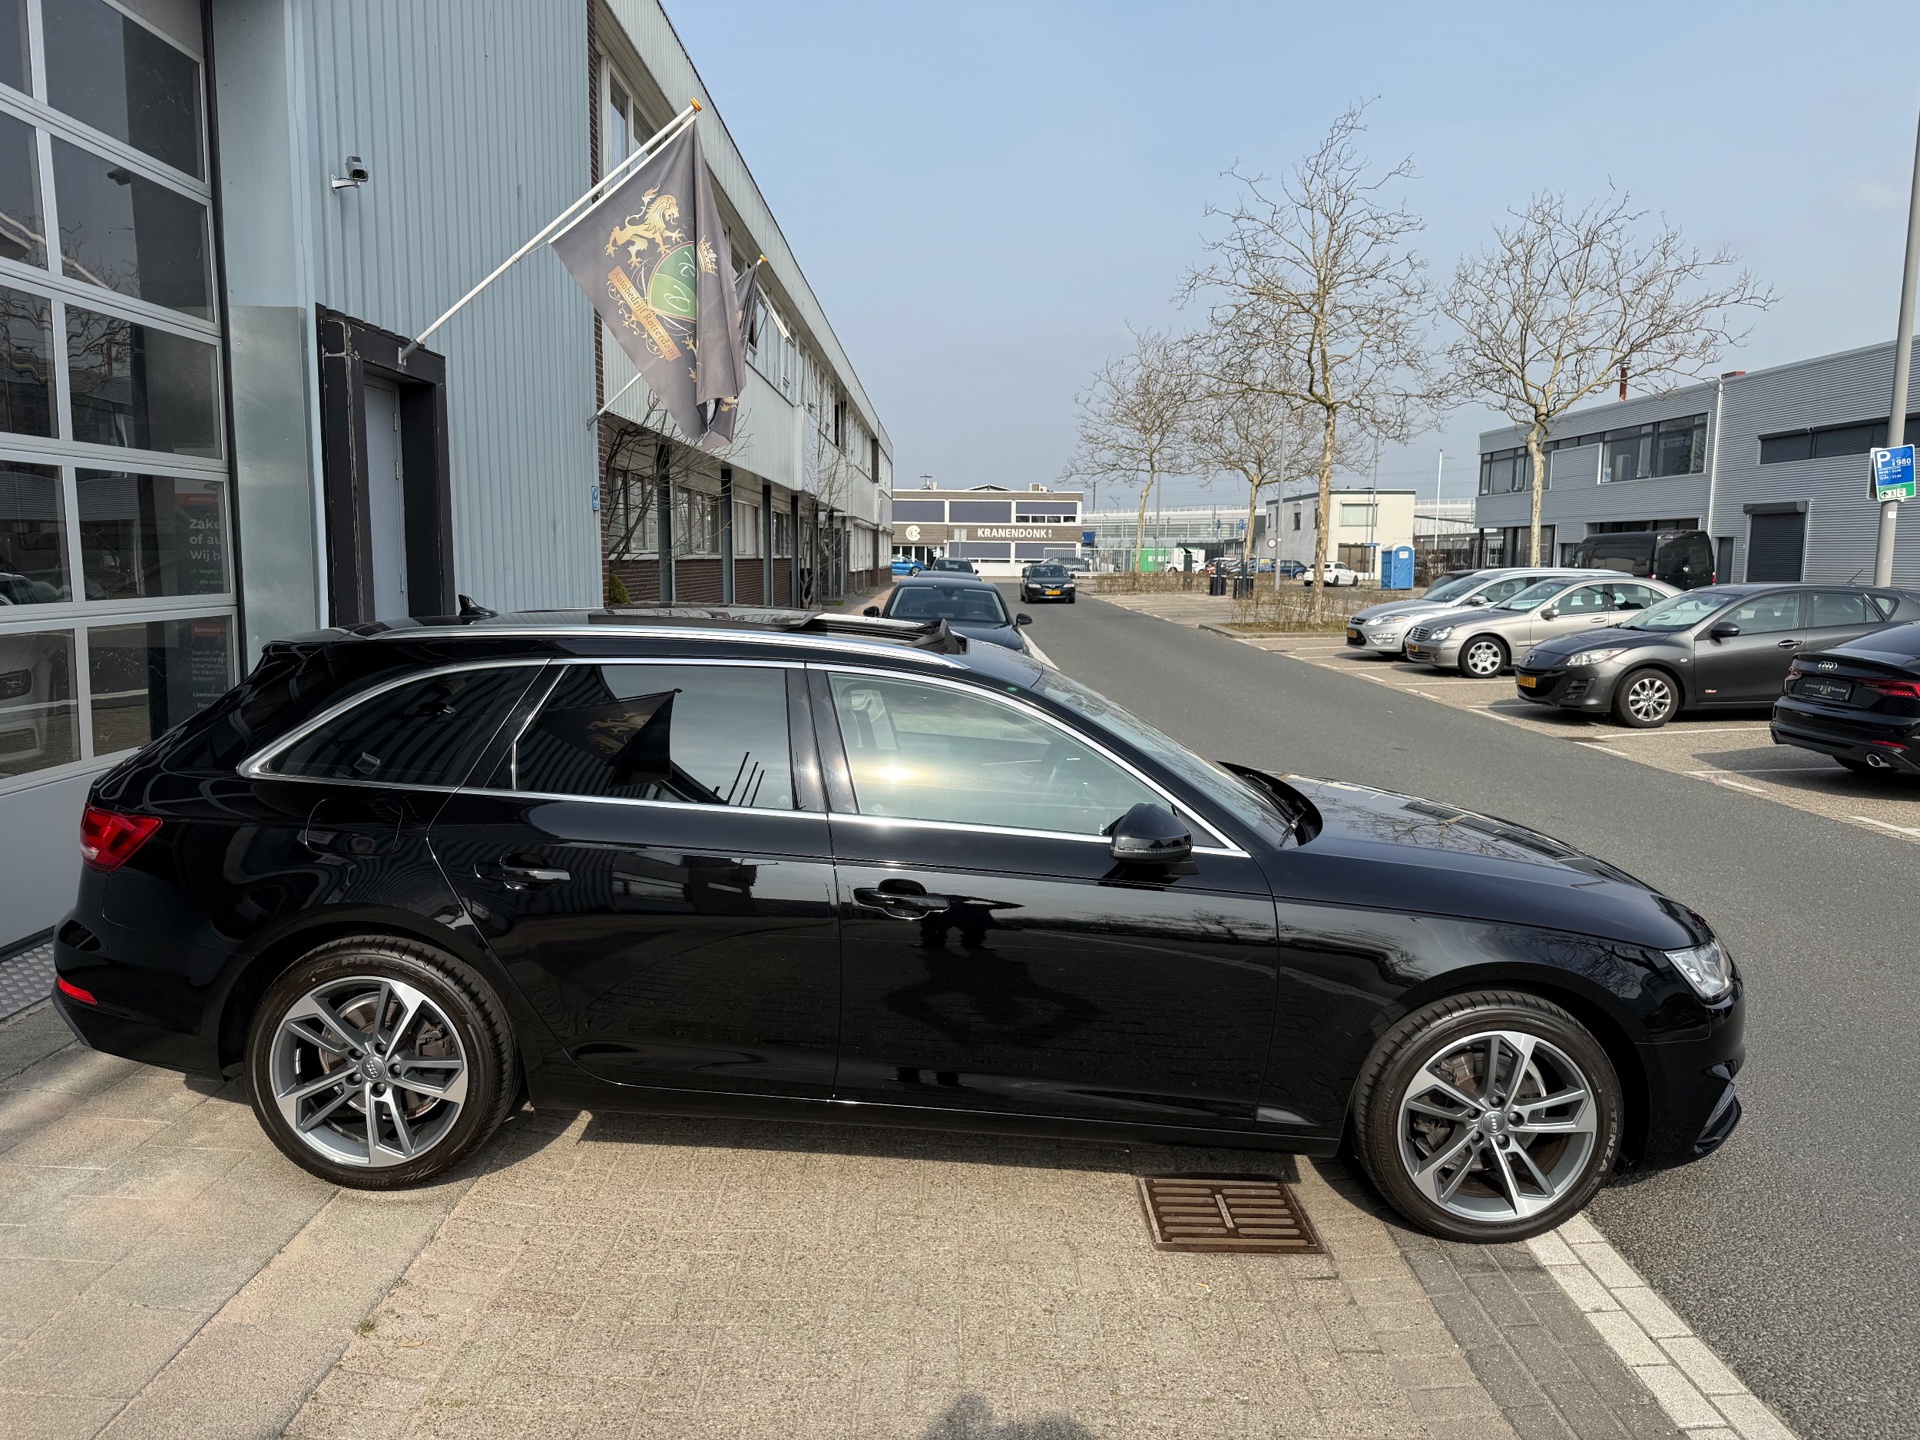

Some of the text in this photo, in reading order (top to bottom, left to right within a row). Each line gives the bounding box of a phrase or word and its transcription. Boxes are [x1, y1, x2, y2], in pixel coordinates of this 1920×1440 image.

[612, 271, 676, 358] Autobedrijf Rotterdam
[1876, 451, 1891, 468] P
[189, 533, 204, 545] of
[977, 528, 1047, 538] KRANENDONK
[190, 550, 210, 562] Wij
